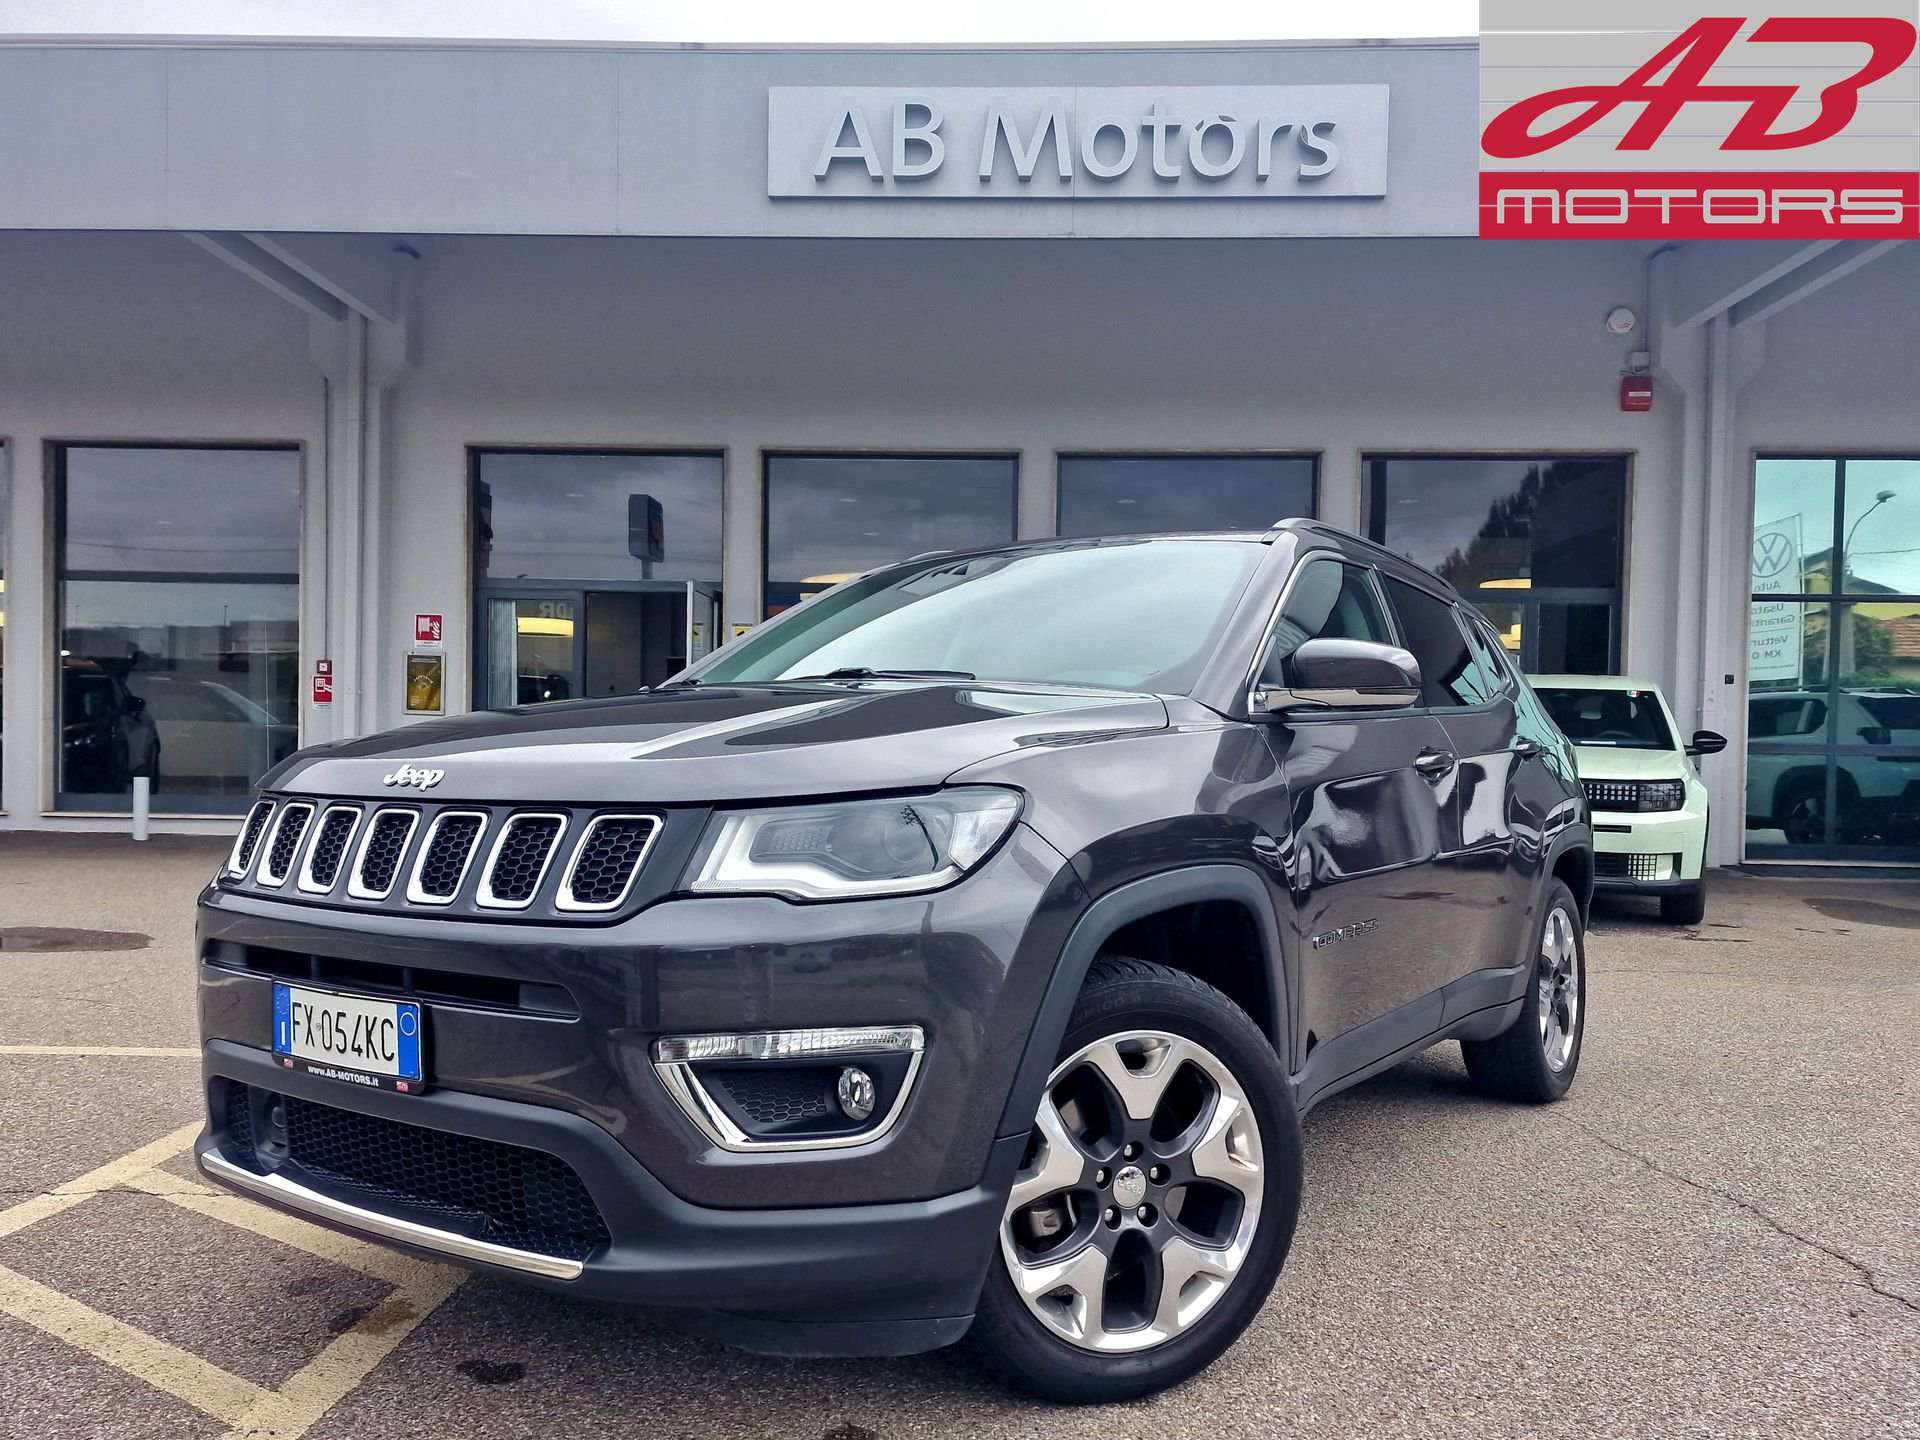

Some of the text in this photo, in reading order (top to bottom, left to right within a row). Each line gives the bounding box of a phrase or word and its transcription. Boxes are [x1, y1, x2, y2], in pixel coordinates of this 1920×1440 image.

[813, 94, 1341, 184] AB Motors
[383, 763, 445, 792] Jeep
[307, 1065, 379, 1088] www.AB-MOTORS.it
